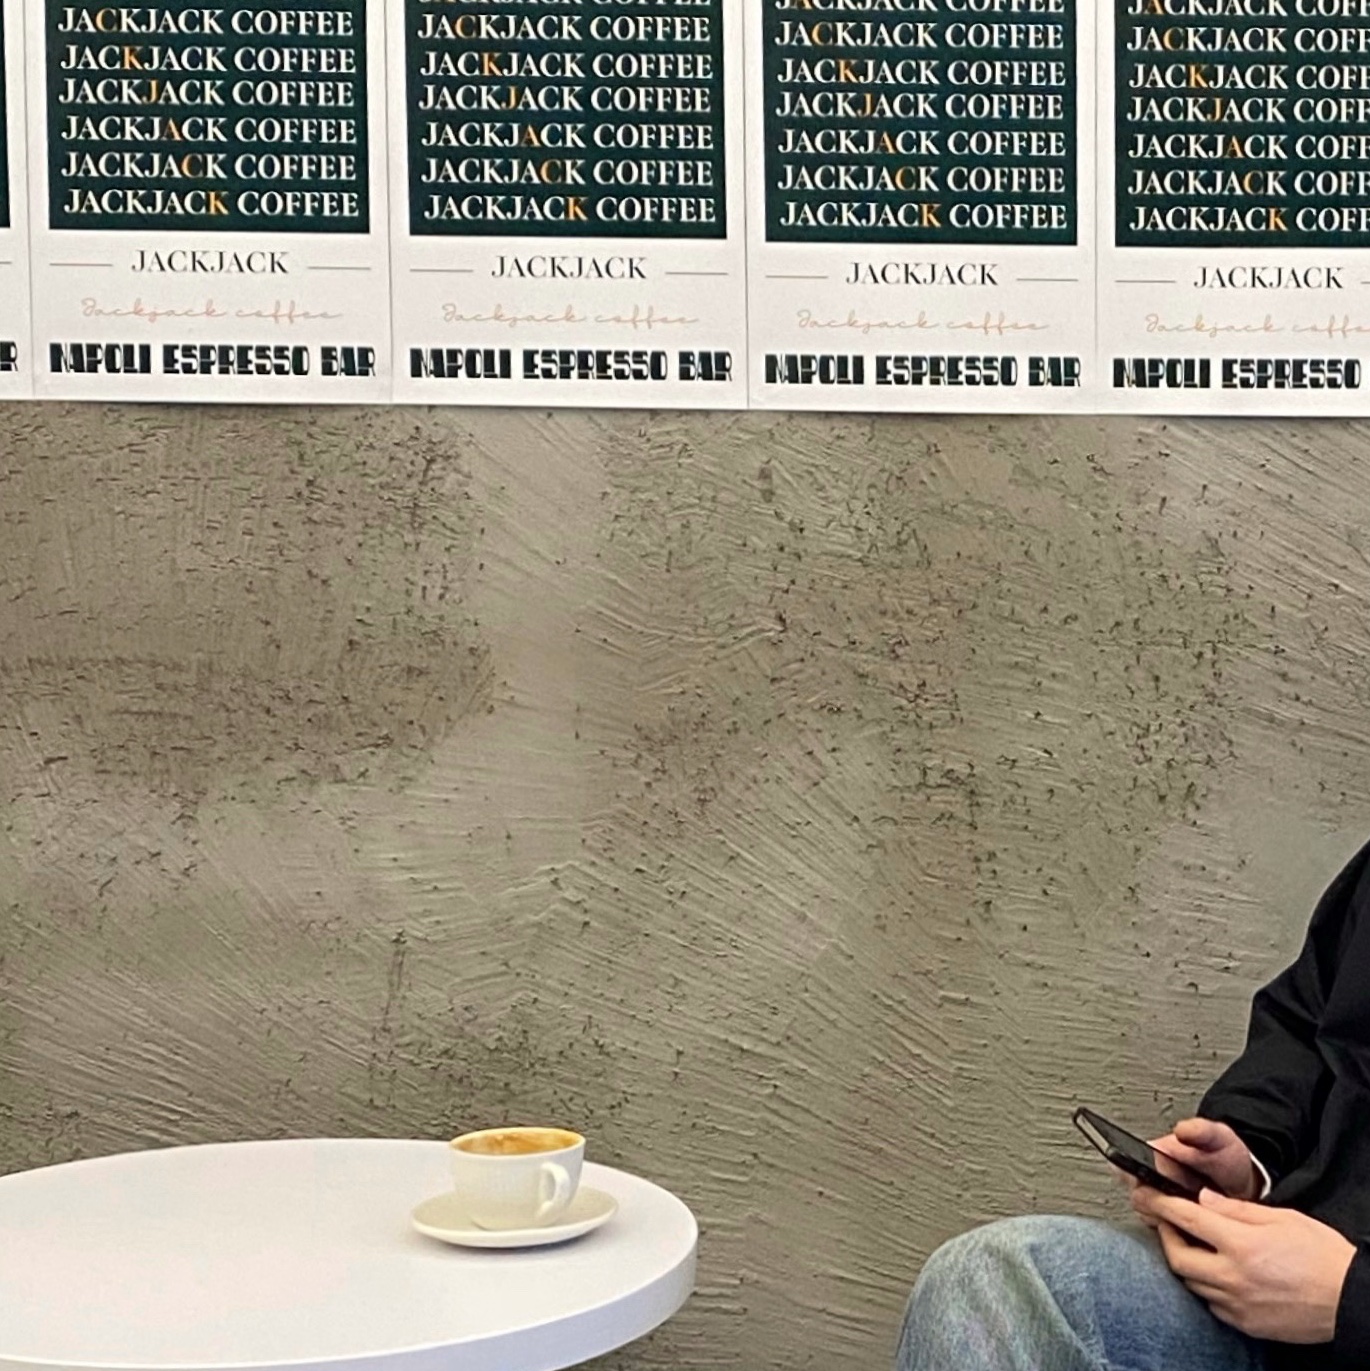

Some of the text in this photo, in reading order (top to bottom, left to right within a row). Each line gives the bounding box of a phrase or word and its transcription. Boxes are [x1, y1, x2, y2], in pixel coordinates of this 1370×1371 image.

[58, 8, 353, 36] JACKJACK COFFEE
[418, 14, 710, 41] JACKJACK COFFEE
[775, 21, 1063, 49] JACKJACK COFFEE
[1127, 27, 1286, 52] JACKJACK
[61, 45, 356, 73] JACKJACK COFFEE
[420, 52, 713, 78] JACKJACK COFFEE
[778, 59, 1065, 86] JACKJACK COFFEE
[1129, 64, 1288, 89] JACKJACK
[59, 79, 354, 106] JACKJACK COFFEE
[419, 85, 710, 112] JACKJACK COFFEE
[776, 92, 1063, 119] JACKJACK COFFEE
[1127, 97, 1285, 123] JACKJACK
[62, 116, 356, 144] JACKJACK COFFEE
[422, 122, 713, 149] JACKJACK COFFEE
[778, 129, 1065, 156] JACKJACK COFFEE
[1129, 134, 1287, 159] JACKJACK
[61, 152, 356, 180] JACKJACK COFFEE
[421, 158, 713, 186] JACKJACK COFFEE
[778, 165, 1065, 192] JACKJACK COFFEE
[1128, 170, 1286, 196] JACKJACK
[64, 189, 358, 216] JACKJACK COFFEE
[424, 195, 715, 222] JACKJACK COFFEE
[780, 202, 1067, 229] JACKJACK COFFEE
[1130, 207, 1287, 231] JACKJACK
[132, 251, 287, 273] JACKJACK
[492, 257, 645, 278] JACKJACK
[847, 263, 996, 285] JACKJACK
[1194, 267, 1342, 288] JACKJACK
[50, 343, 151, 374] NAPOLI
[163, 345, 309, 375] ESPRESSO
[321, 347, 375, 376] BAR
[410, 349, 732, 381] NAPOLI ESPRESSO BAR
[765, 355, 1080, 386] NAPOLI ESPRESSO BAR
[1113, 358, 1210, 388] NAPOLI
[1222, 359, 1360, 389] ESPRESSO
